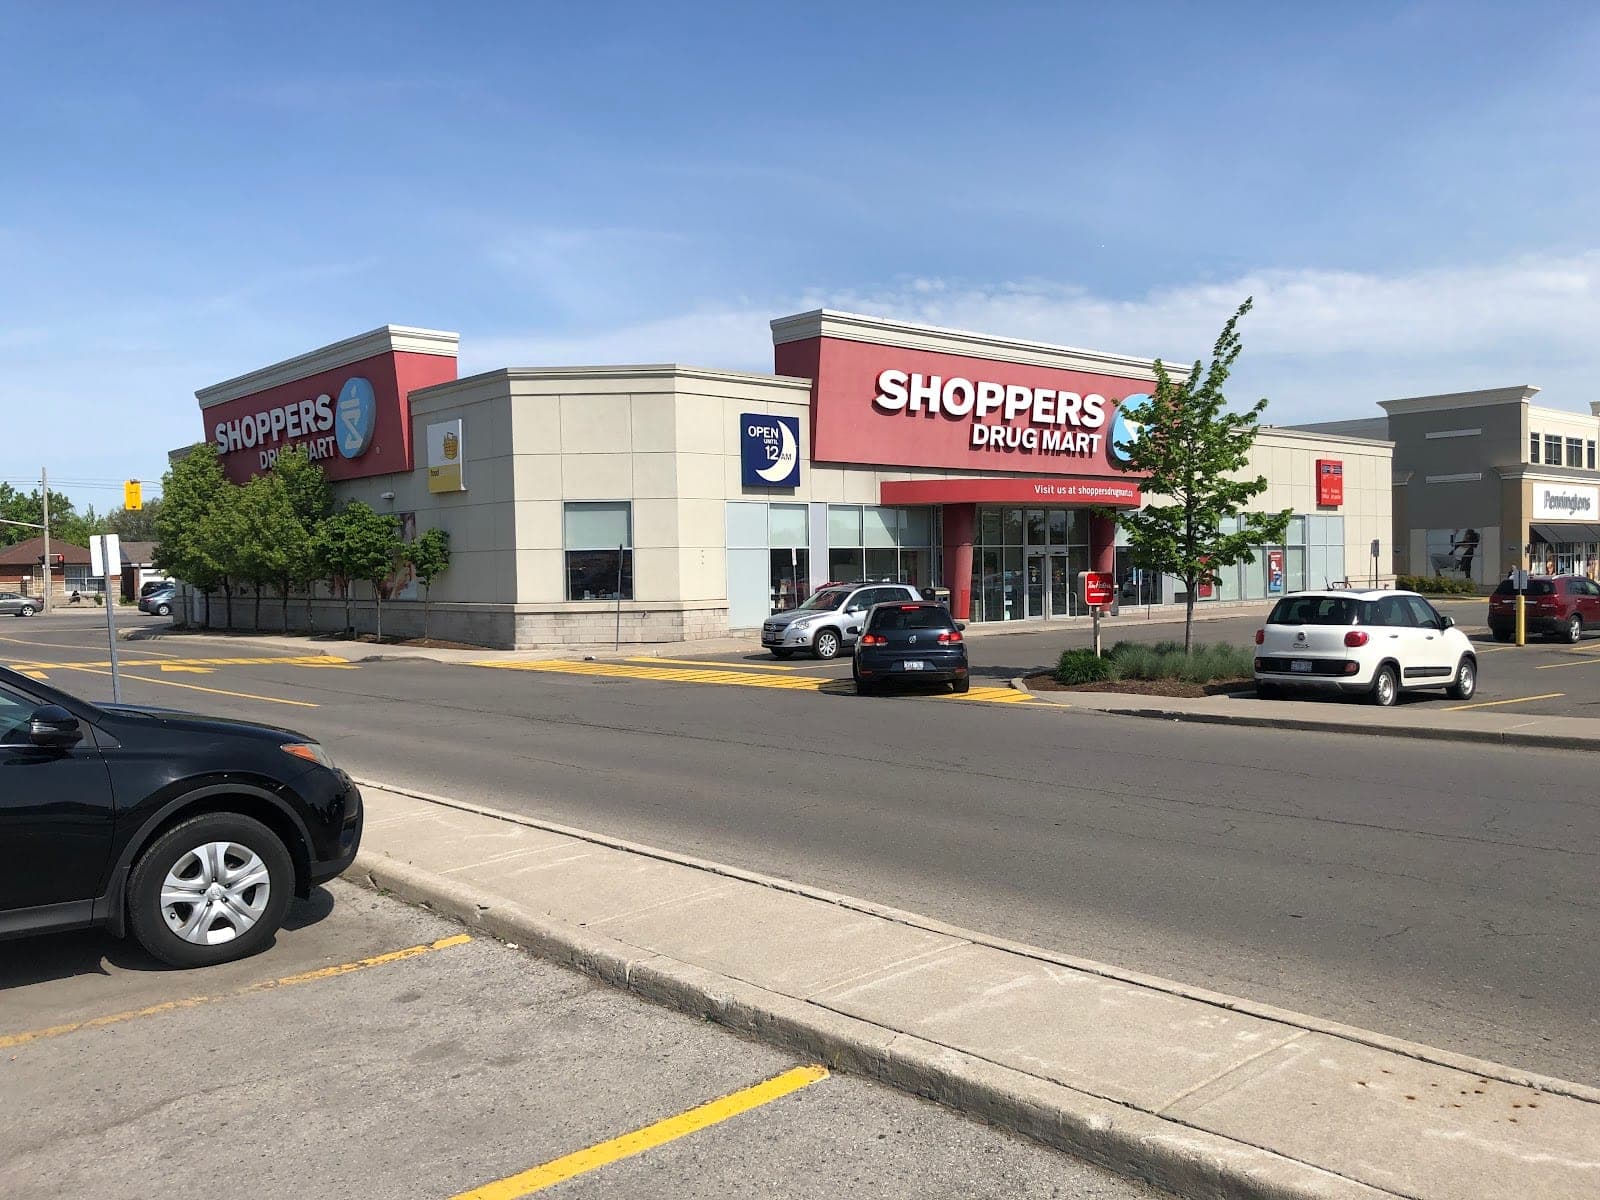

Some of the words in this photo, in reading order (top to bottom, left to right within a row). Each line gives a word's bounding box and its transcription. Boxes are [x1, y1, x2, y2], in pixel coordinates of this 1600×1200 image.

[876, 369, 1106, 428] SHOPPERS
[215, 394, 334, 455] SHOPPERS
[748, 425, 779, 439] OPEN
[972, 423, 1038, 449] DRUG
[1042, 431, 1102, 454] MART
[765, 445, 779, 460] 12
[780, 453, 792, 461] AM
[1034, 484, 1054, 494] Visit
[1057, 486, 1066, 494] us
[1068, 486, 1076, 495] at
[1544, 490, 1591, 516] Penningtons
